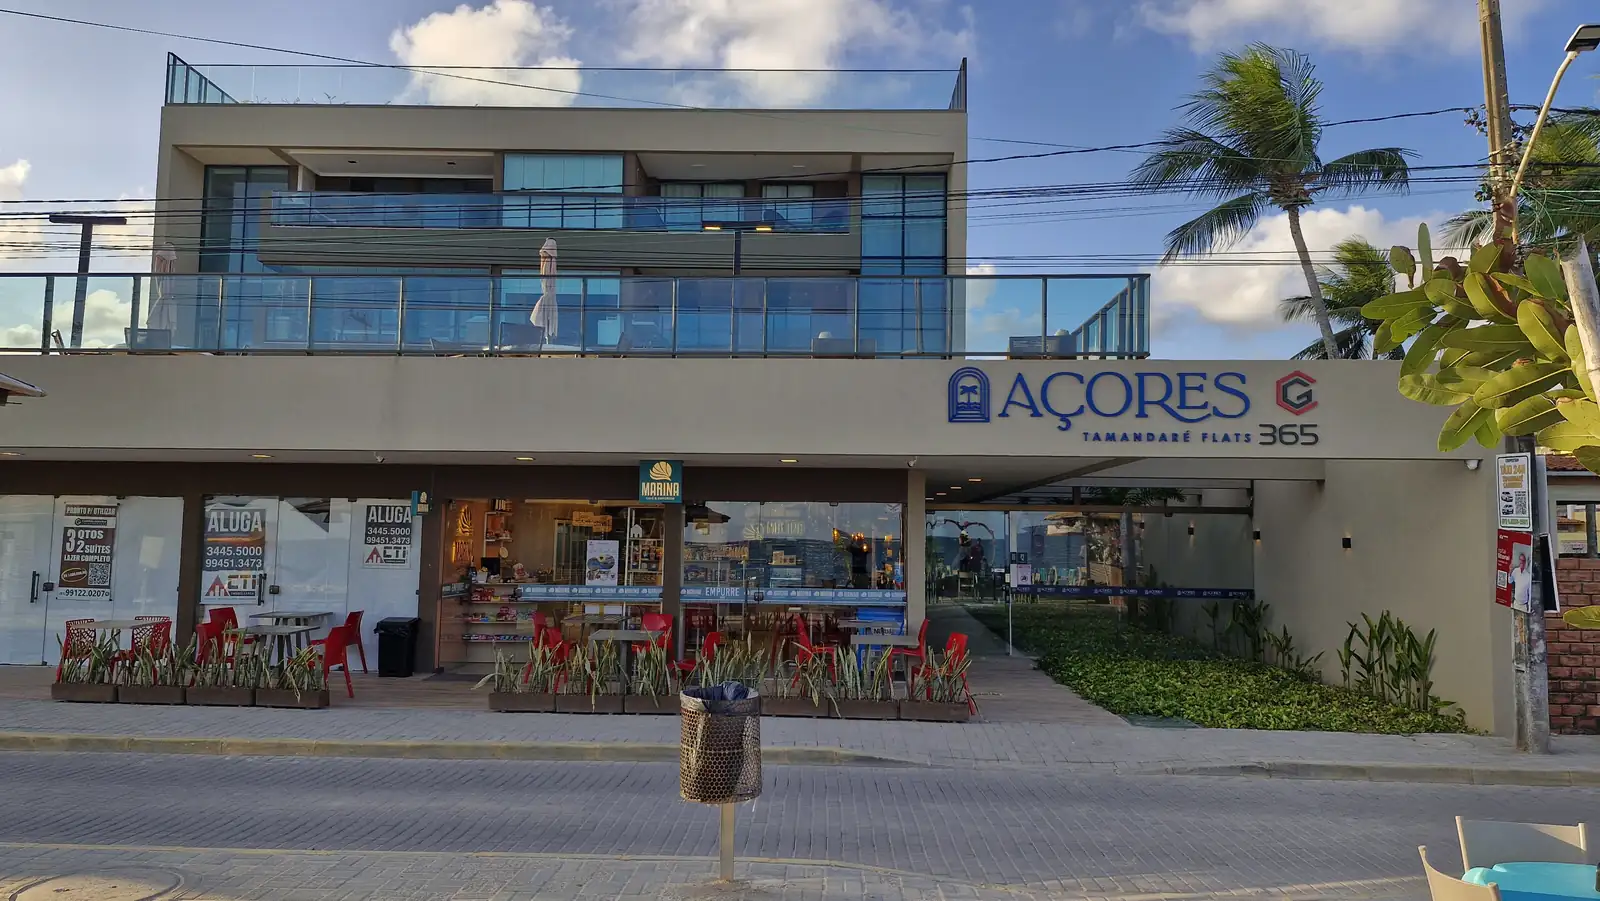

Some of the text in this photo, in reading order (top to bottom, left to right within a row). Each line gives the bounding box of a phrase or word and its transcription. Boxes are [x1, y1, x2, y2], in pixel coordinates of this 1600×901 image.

[998, 371, 1250, 431] AÇORES
[1083, 430, 1252, 442] TAMANDARÉ FLATS
[1259, 423, 1319, 445] 365
[641, 482, 680, 496] MARINA
[368, 506, 412, 523] ALUGA
[208, 511, 262, 532] ALUGA
[367, 527, 411, 535] 3445.5000
[66, 529, 104, 552] 3 QTOS
[366, 536, 410, 544] 99451.3473
[76, 540, 110, 554] 2 SUÍTES
[206, 546, 262, 556] 3445.5000
[64, 554, 111, 562] LAZER COMPLETO
[205, 558, 262, 568] 99451.3473
[65, 589, 106, 597] 99122.0207
[705, 587, 740, 597] EMPURRE
